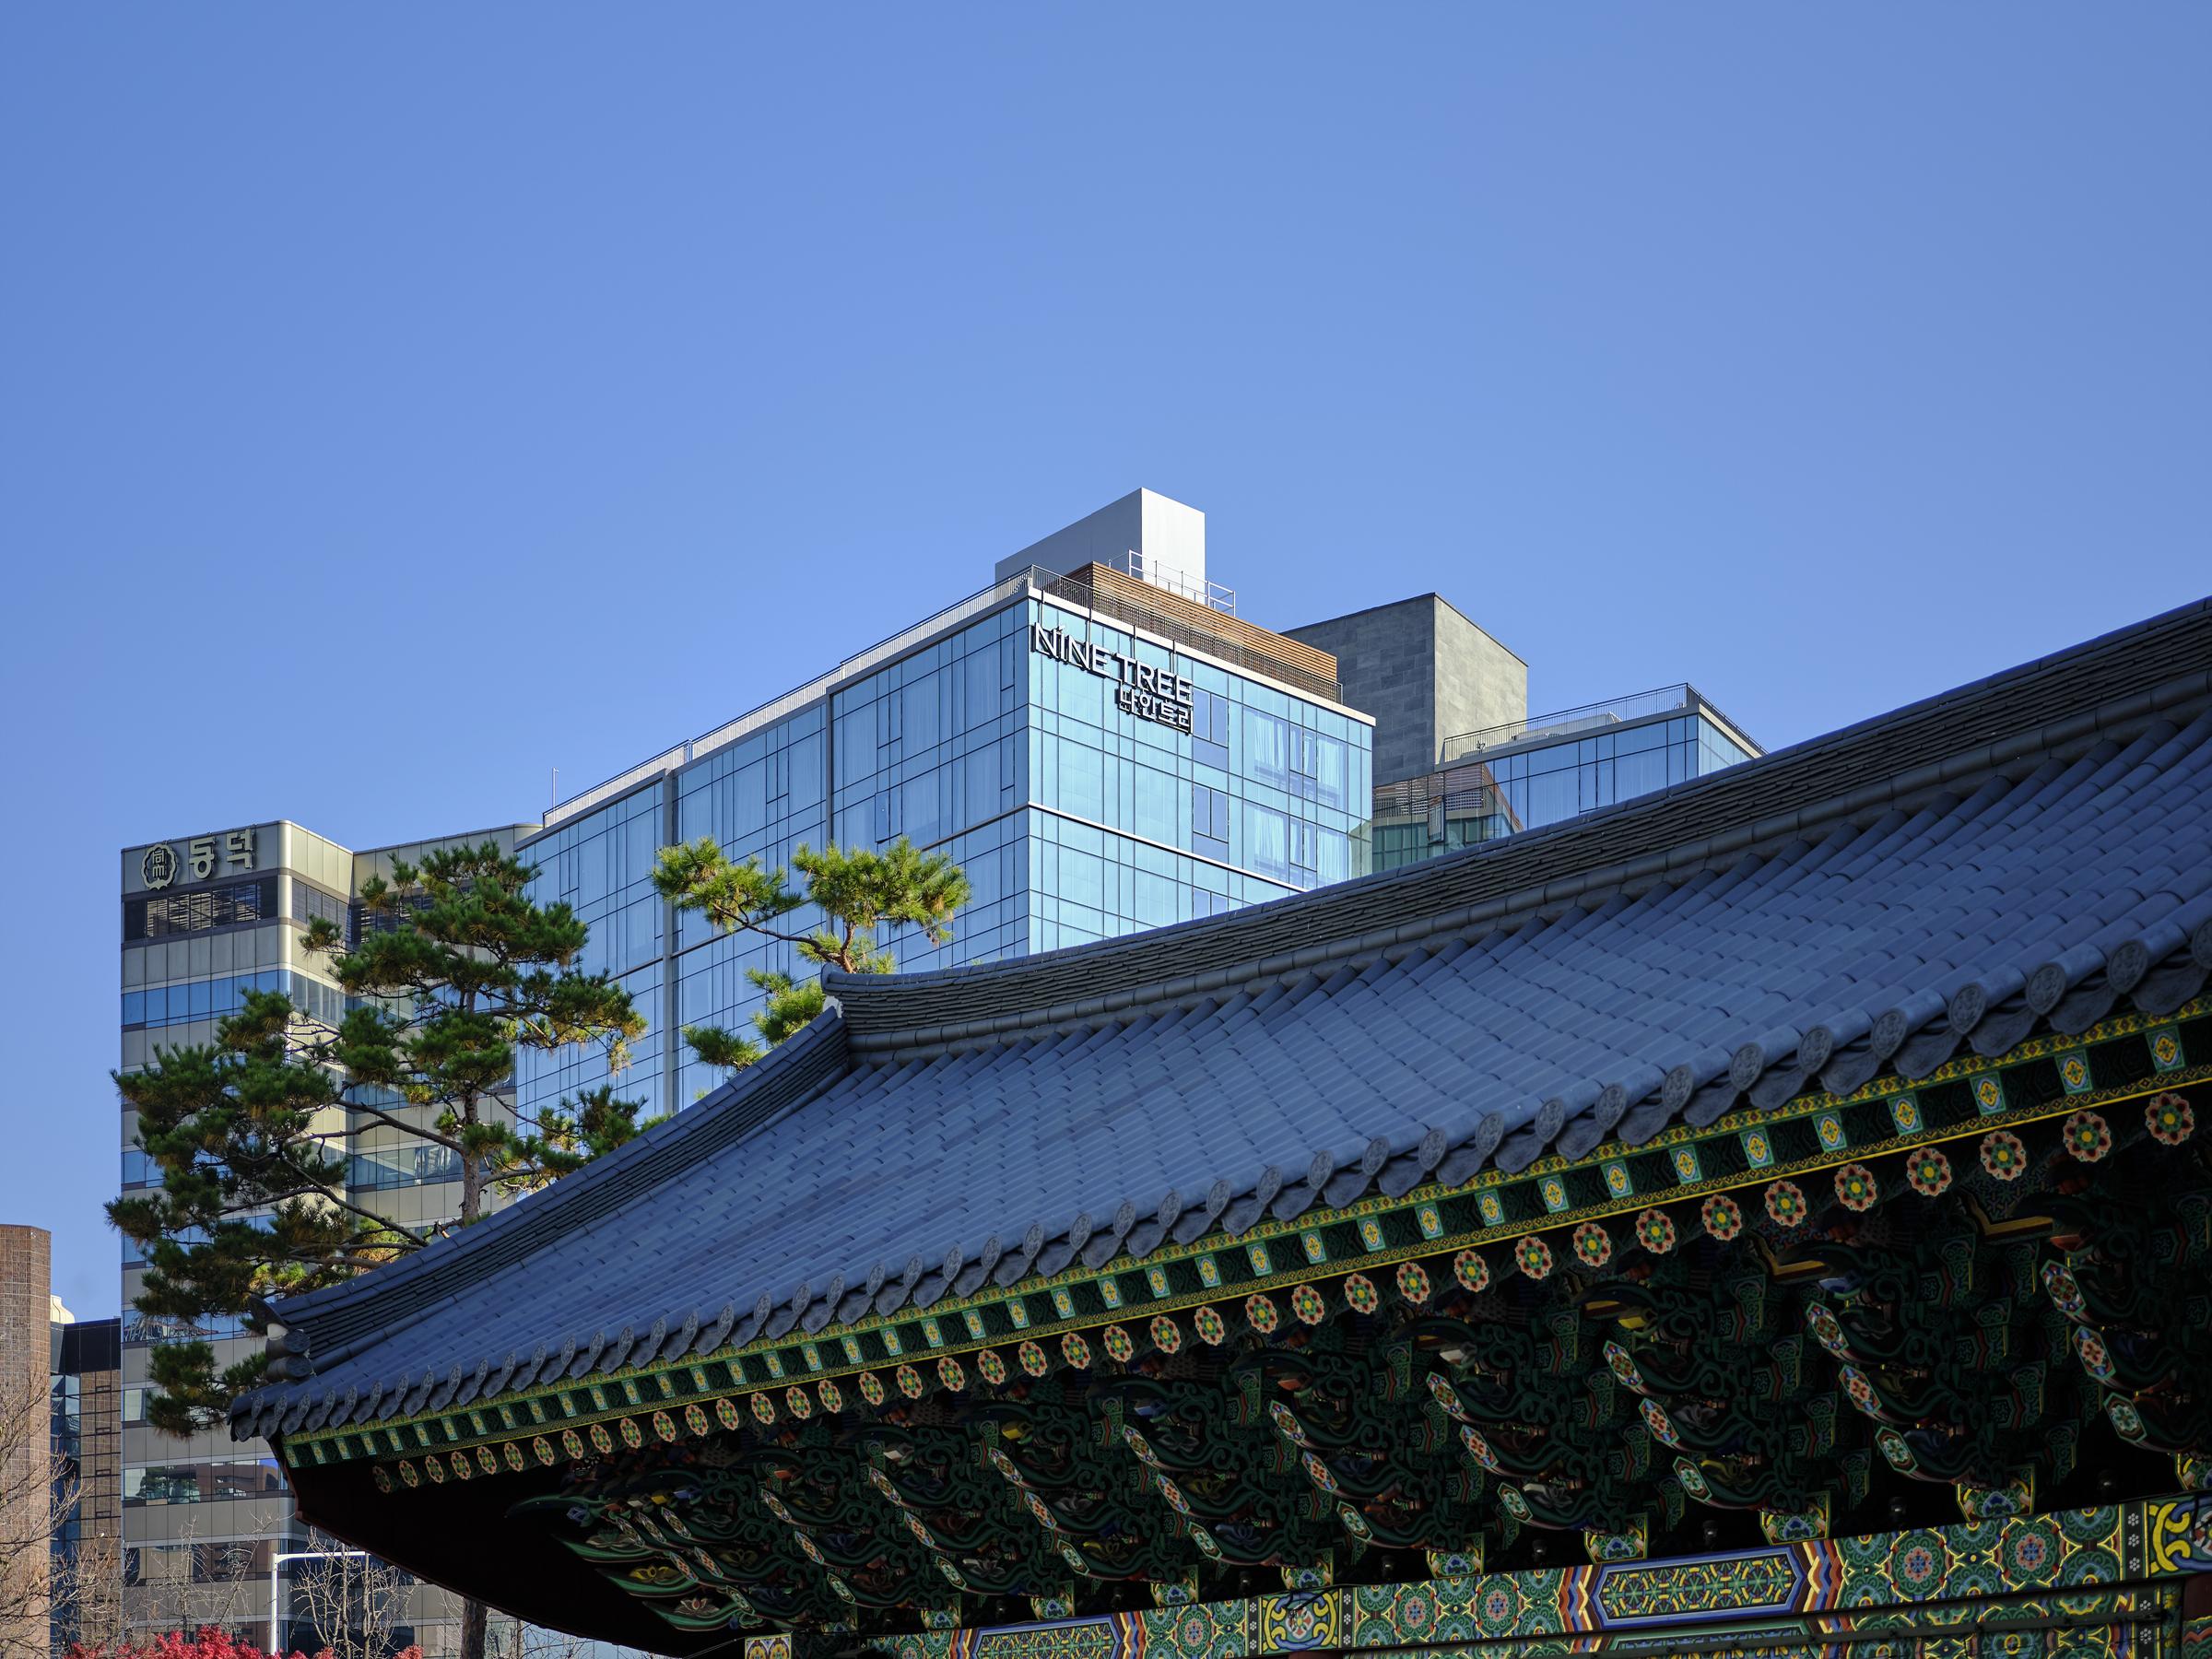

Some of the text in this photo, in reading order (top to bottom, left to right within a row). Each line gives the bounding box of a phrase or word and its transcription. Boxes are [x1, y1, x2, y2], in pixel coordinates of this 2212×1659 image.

[1033, 621, 1194, 707] NINE TREE
[1119, 686, 1194, 735] 나인트리
[189, 829, 253, 879] 동덕
